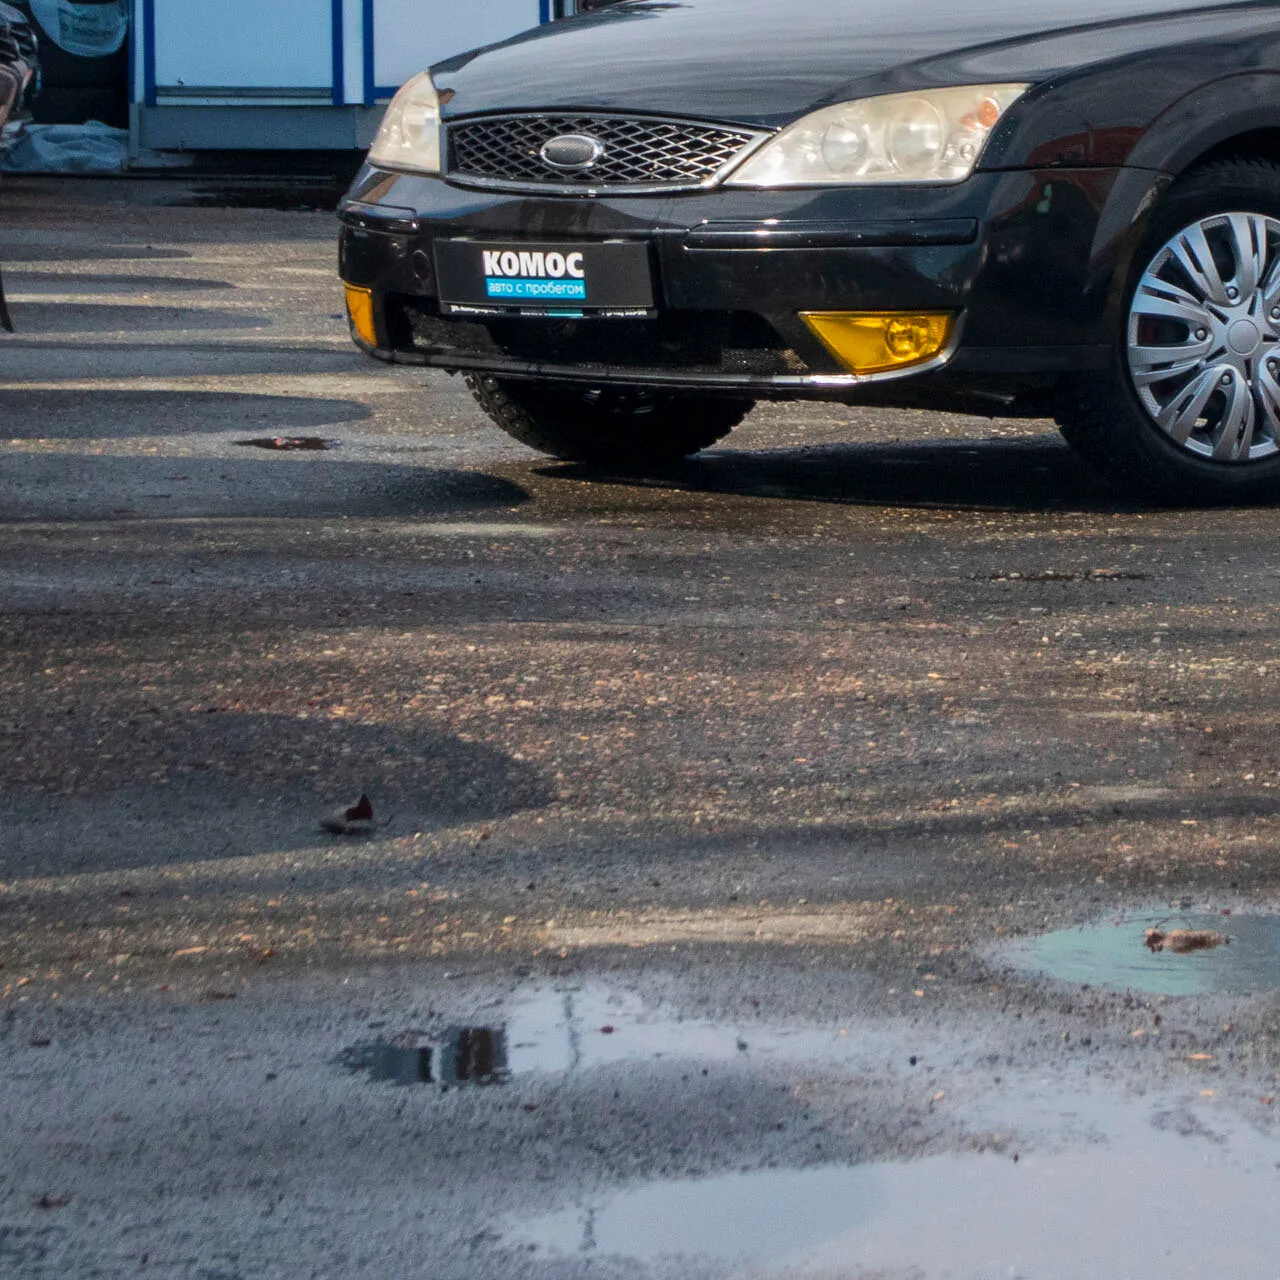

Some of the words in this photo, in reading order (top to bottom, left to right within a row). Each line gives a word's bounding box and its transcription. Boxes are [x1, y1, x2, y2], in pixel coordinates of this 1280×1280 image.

[482, 250, 585, 278] КОМОС
[488, 282, 512, 293] авто
[516, 284, 522, 293] с
[526, 281, 584, 296] пробегом
